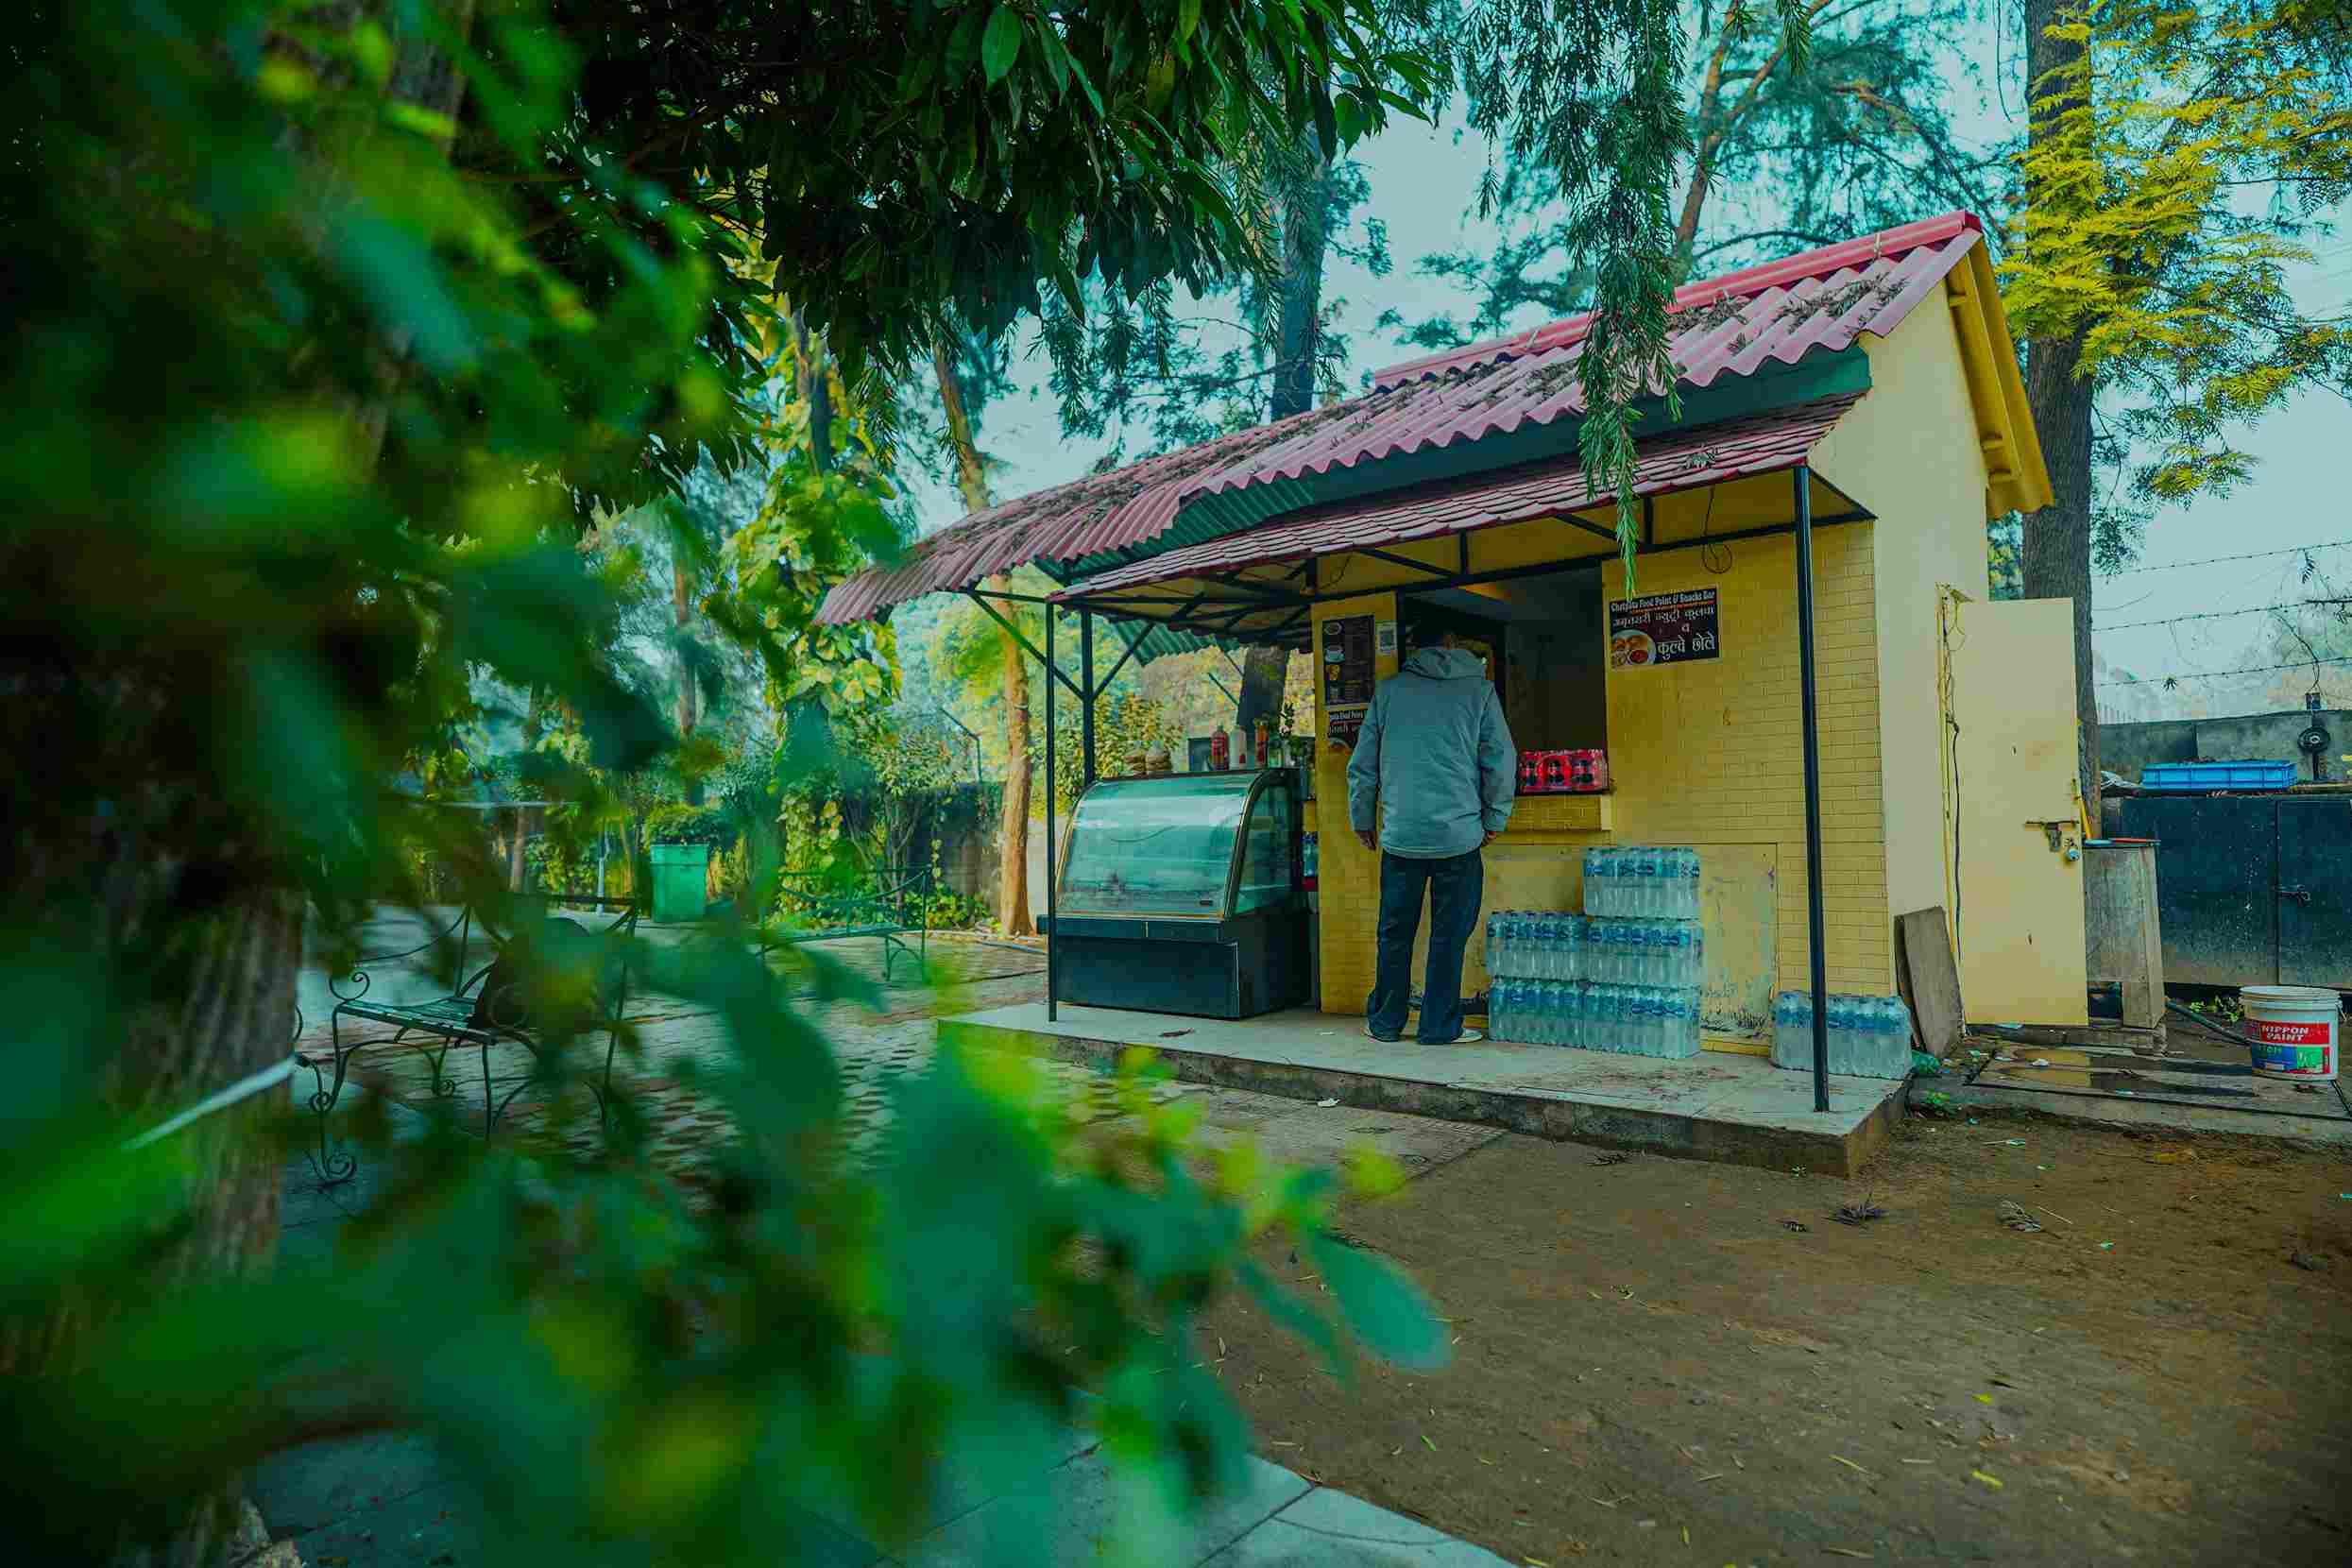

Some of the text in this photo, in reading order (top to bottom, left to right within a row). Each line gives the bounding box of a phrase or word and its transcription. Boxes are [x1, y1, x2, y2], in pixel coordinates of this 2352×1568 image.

[1655, 596, 1672, 605] Point
[2261, 1025, 2309, 1034] NIPPON
[2266, 1032, 2305, 1042] PAINT
